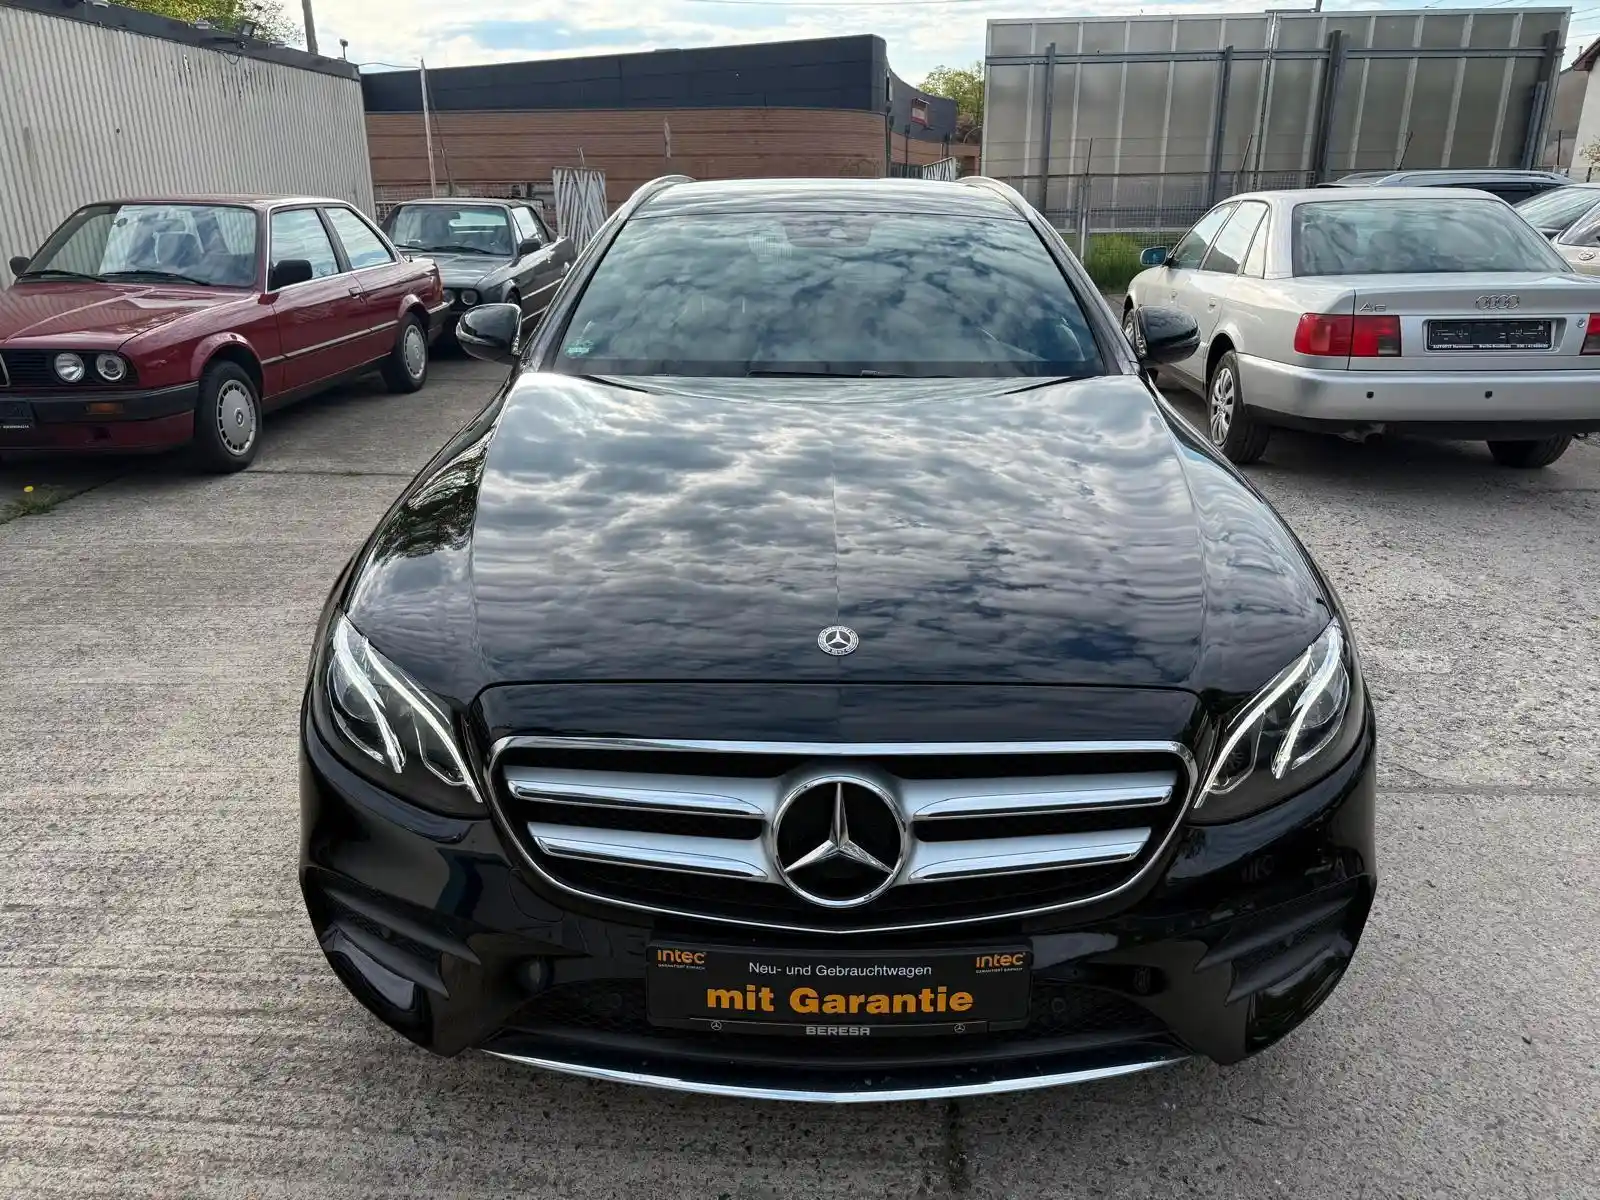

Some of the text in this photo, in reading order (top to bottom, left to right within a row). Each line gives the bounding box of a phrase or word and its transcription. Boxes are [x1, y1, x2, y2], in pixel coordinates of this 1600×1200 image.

[1360, 303, 1386, 313] A6
[657, 949, 705, 965] intec
[975, 954, 1024, 969] intec
[749, 962, 932, 979] Neu- und Gebrauchtwagen
[706, 984, 974, 1014] mit Garantie
[805, 1026, 871, 1036] BERESA
